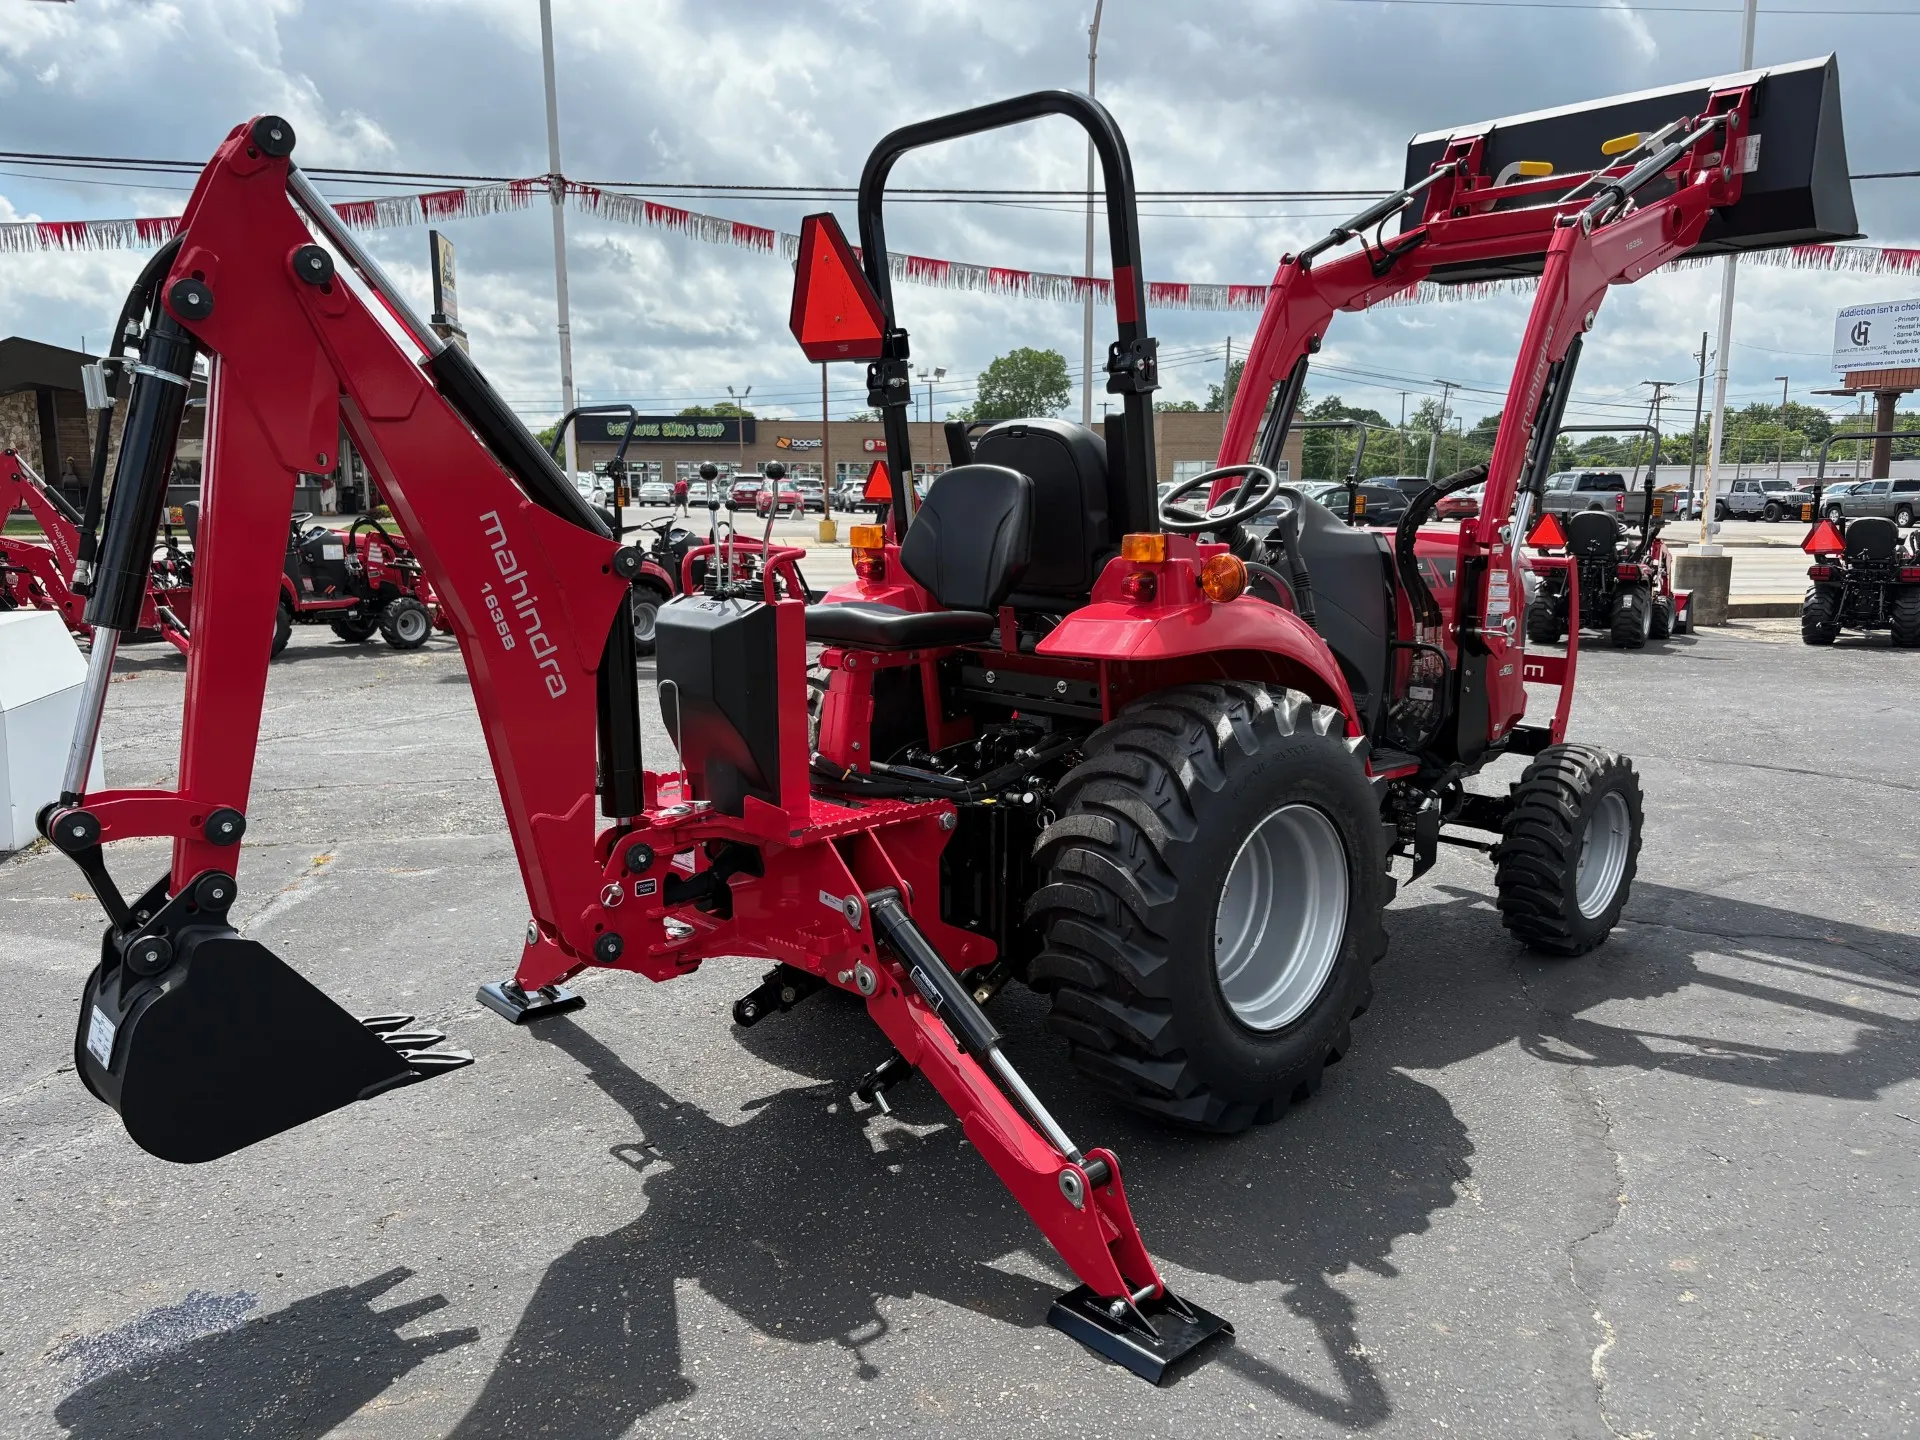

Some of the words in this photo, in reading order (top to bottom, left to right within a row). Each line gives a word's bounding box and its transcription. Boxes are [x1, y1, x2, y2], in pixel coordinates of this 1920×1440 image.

[1839, 307, 1876, 318] Addiction
[1877, 305, 1893, 314] isn't
[1521, 325, 1554, 432] mahindra
[697, 423, 725, 437] SHOP
[792, 438, 822, 447] boost
[52, 523, 75, 564] mahindra
[479, 510, 567, 699] mahindra
[480, 582, 516, 651] 1635B
